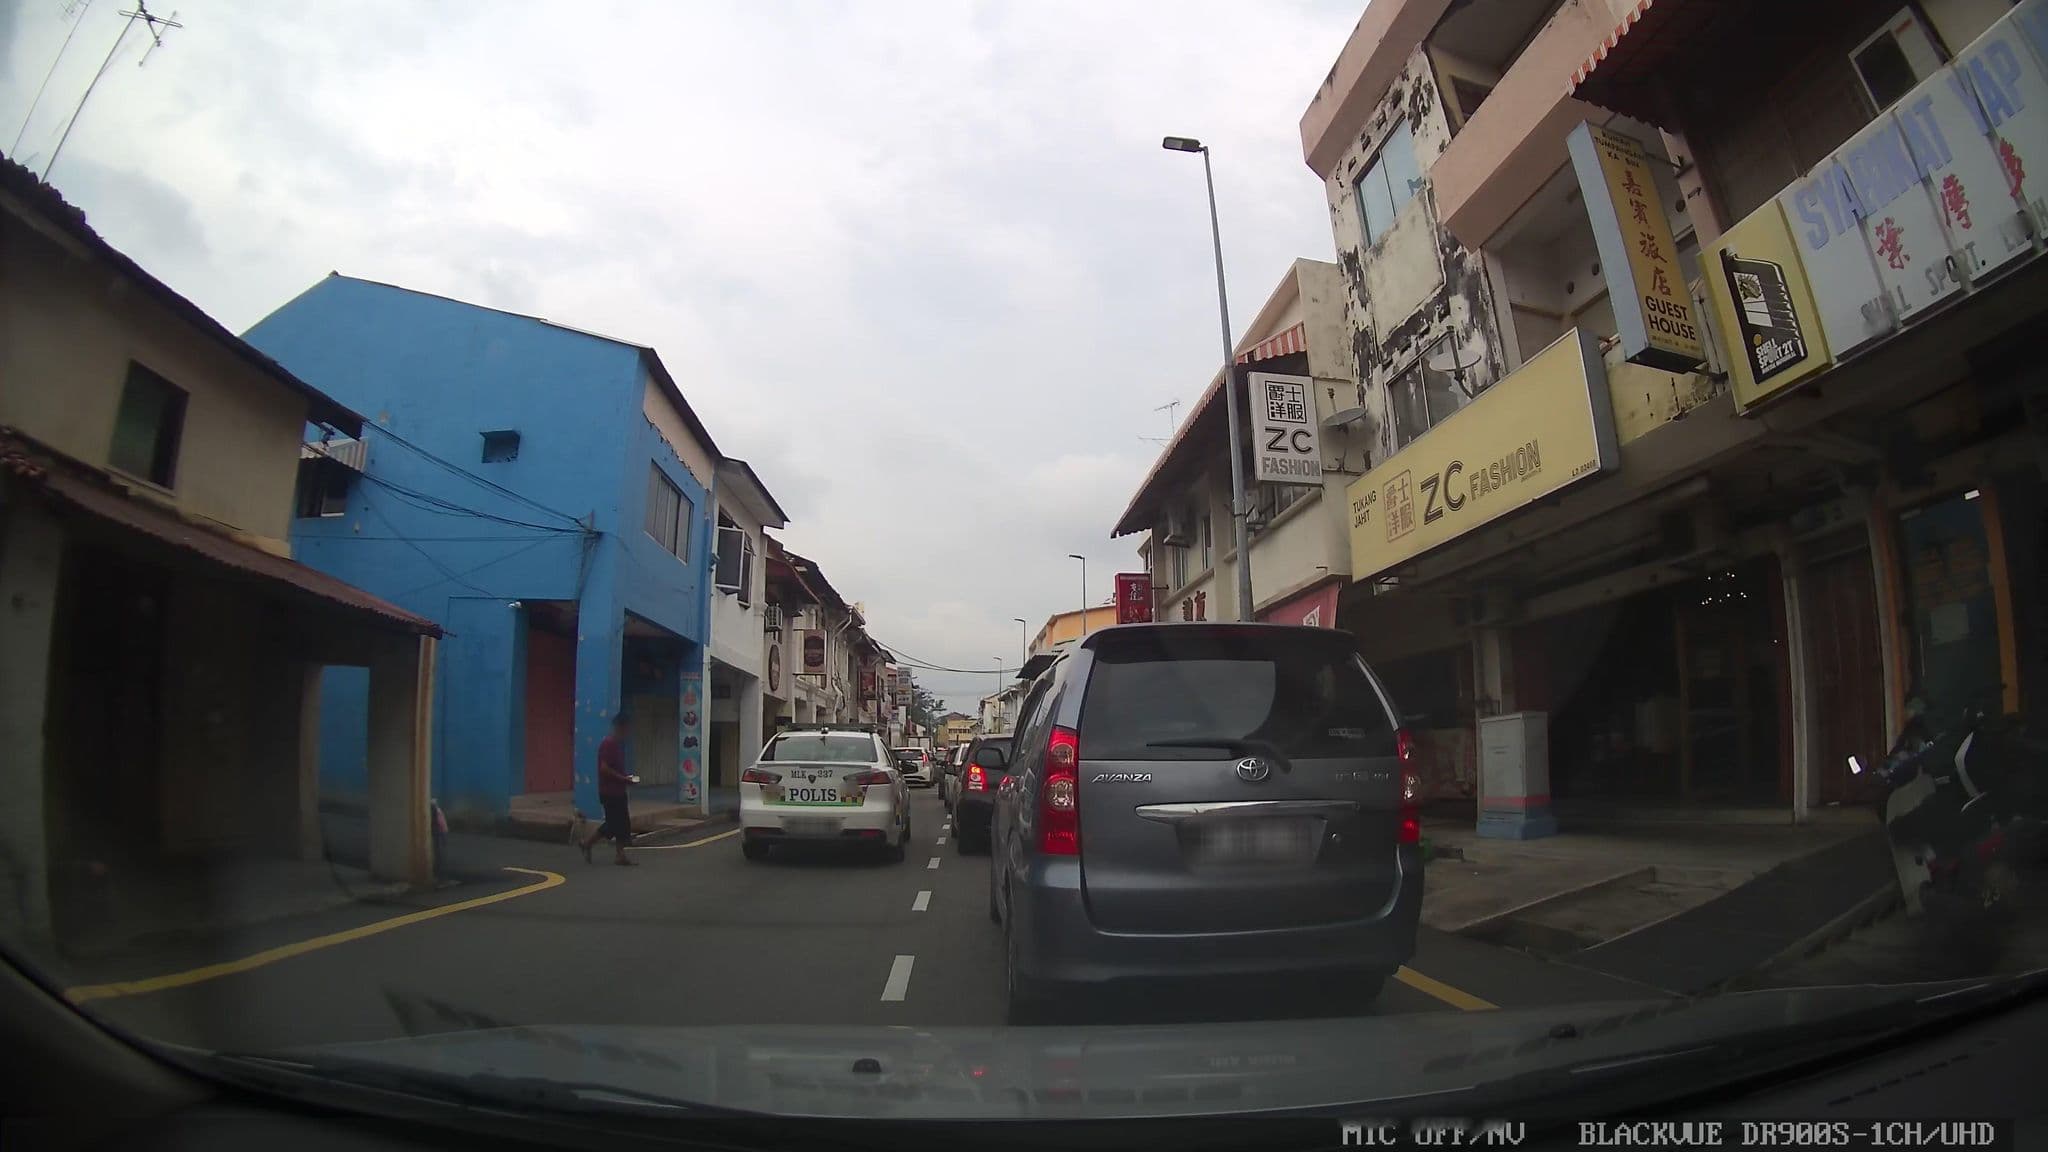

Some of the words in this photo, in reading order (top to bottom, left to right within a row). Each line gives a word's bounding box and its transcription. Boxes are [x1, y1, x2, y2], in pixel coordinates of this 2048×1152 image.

[1645, 296, 1688, 321] GUEST
[1648, 314, 1696, 341] HOUSE
[1268, 384, 1301, 403] 爵士
[1270, 402, 1304, 420] 洋服
[1265, 426, 1313, 455] ZC
[1262, 456, 1321, 477] FASHION
[1420, 460, 1467, 527] ZC
[1469, 438, 1542, 501] FASHION
[1352, 489, 1377, 514] TUKANG
[1354, 509, 1370, 529] JAHIT
[1091, 772, 1152, 783] AVANZA
[789, 788, 837, 802] POLIS
